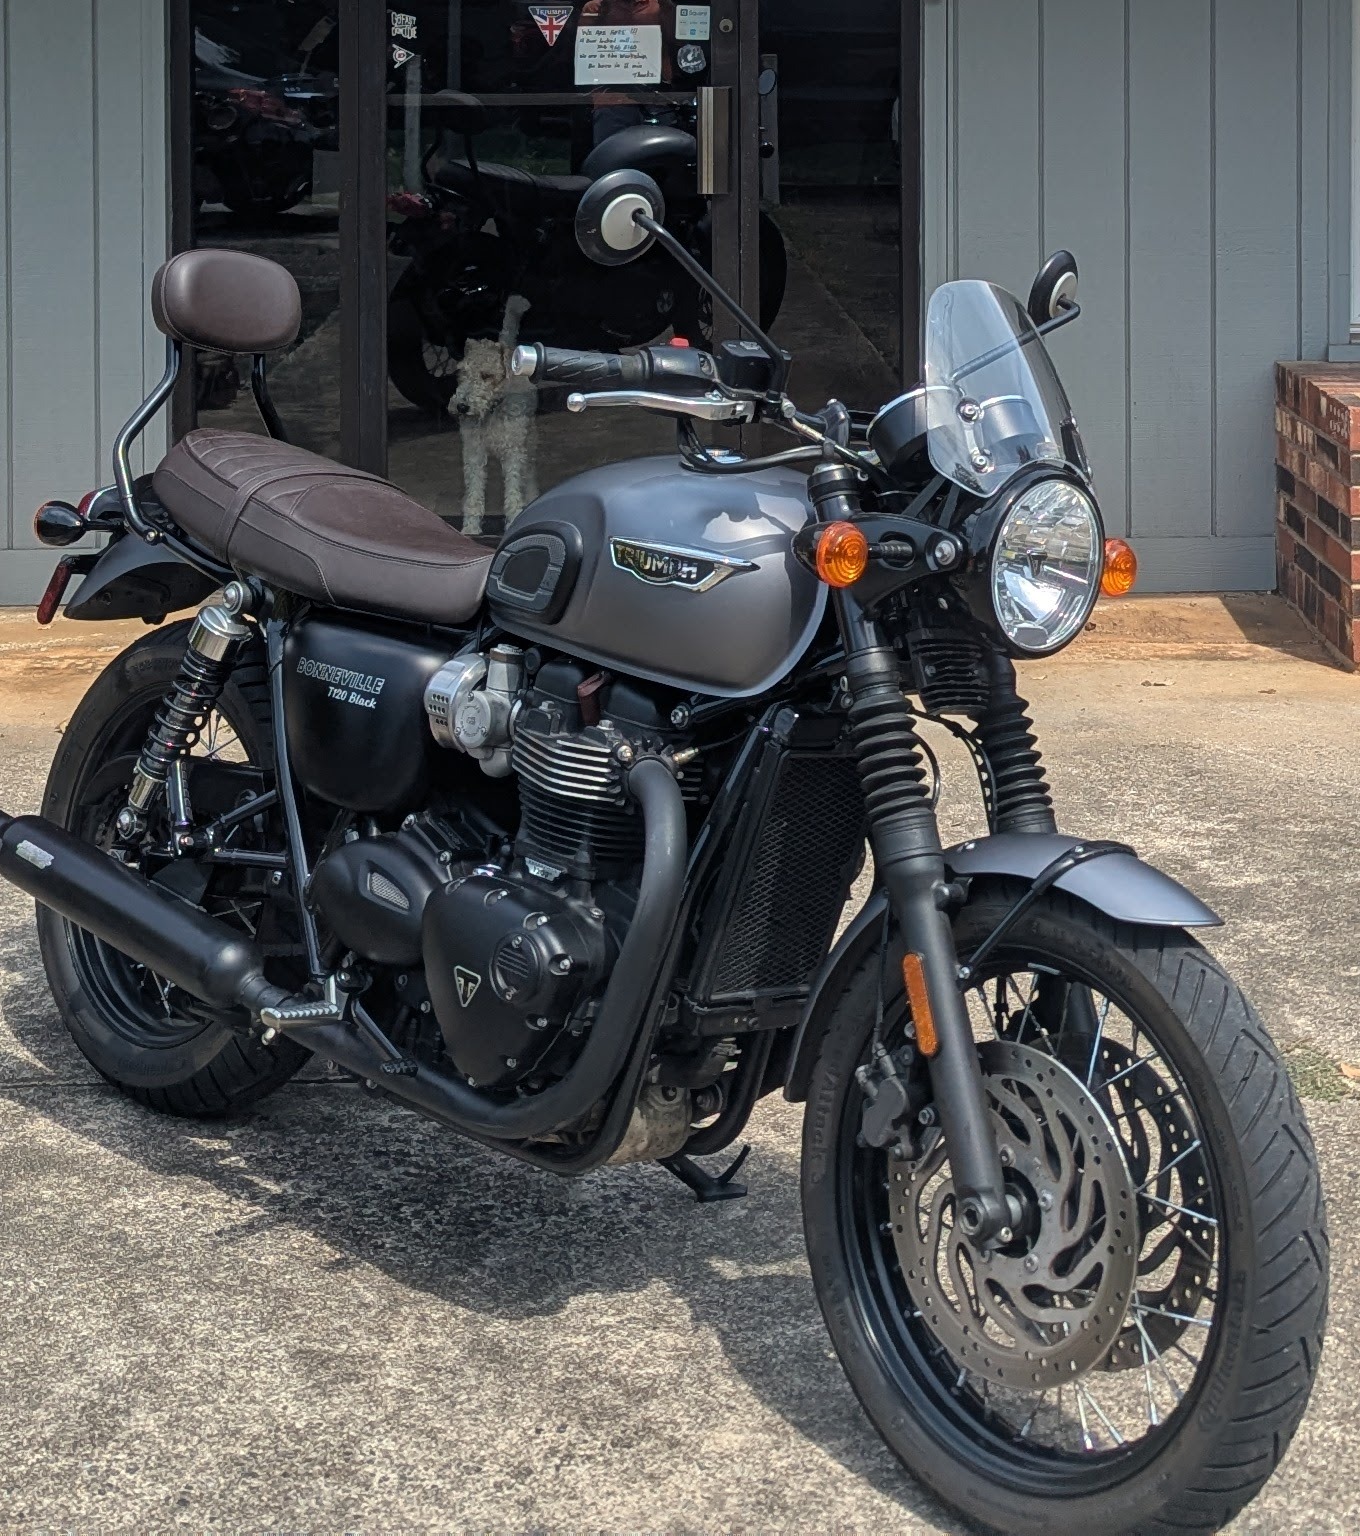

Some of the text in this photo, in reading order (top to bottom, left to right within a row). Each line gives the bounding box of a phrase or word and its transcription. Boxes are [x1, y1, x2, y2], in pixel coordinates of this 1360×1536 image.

[616, 545, 698, 580] TRIUMPH
[297, 657, 385, 694] BONNEVILLE
[348, 691, 377, 709] Black
